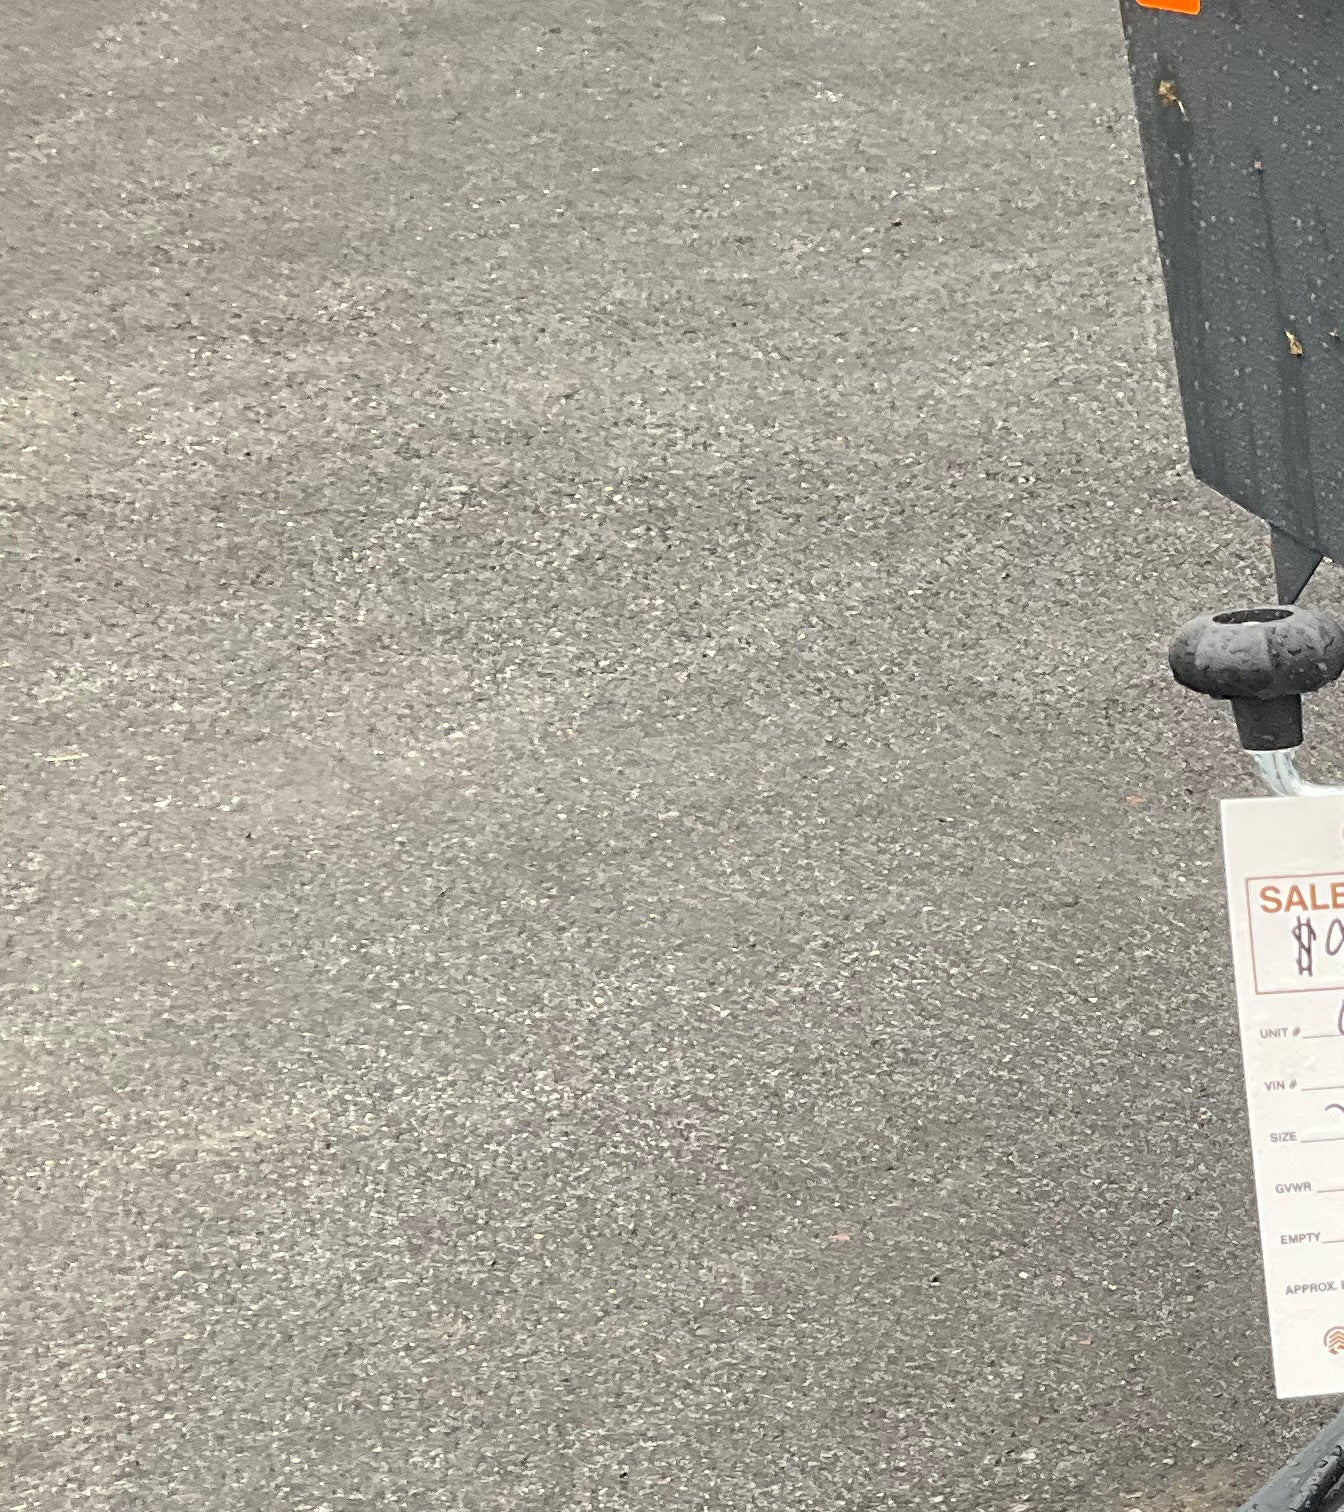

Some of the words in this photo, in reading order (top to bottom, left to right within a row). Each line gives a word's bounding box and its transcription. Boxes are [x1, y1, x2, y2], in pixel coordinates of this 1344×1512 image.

[1259, 1027, 1289, 1040] UNIT
[1292, 1026, 1301, 1037] #
[1264, 1080, 1286, 1092] VIN
[1288, 1079, 1298, 1090] #
[1269, 1132, 1298, 1143] SIZE
[1274, 1181, 1312, 1195] GVWR
[1280, 1231, 1321, 1246] EMPTY
[1285, 1280, 1338, 1297] APPROX.
